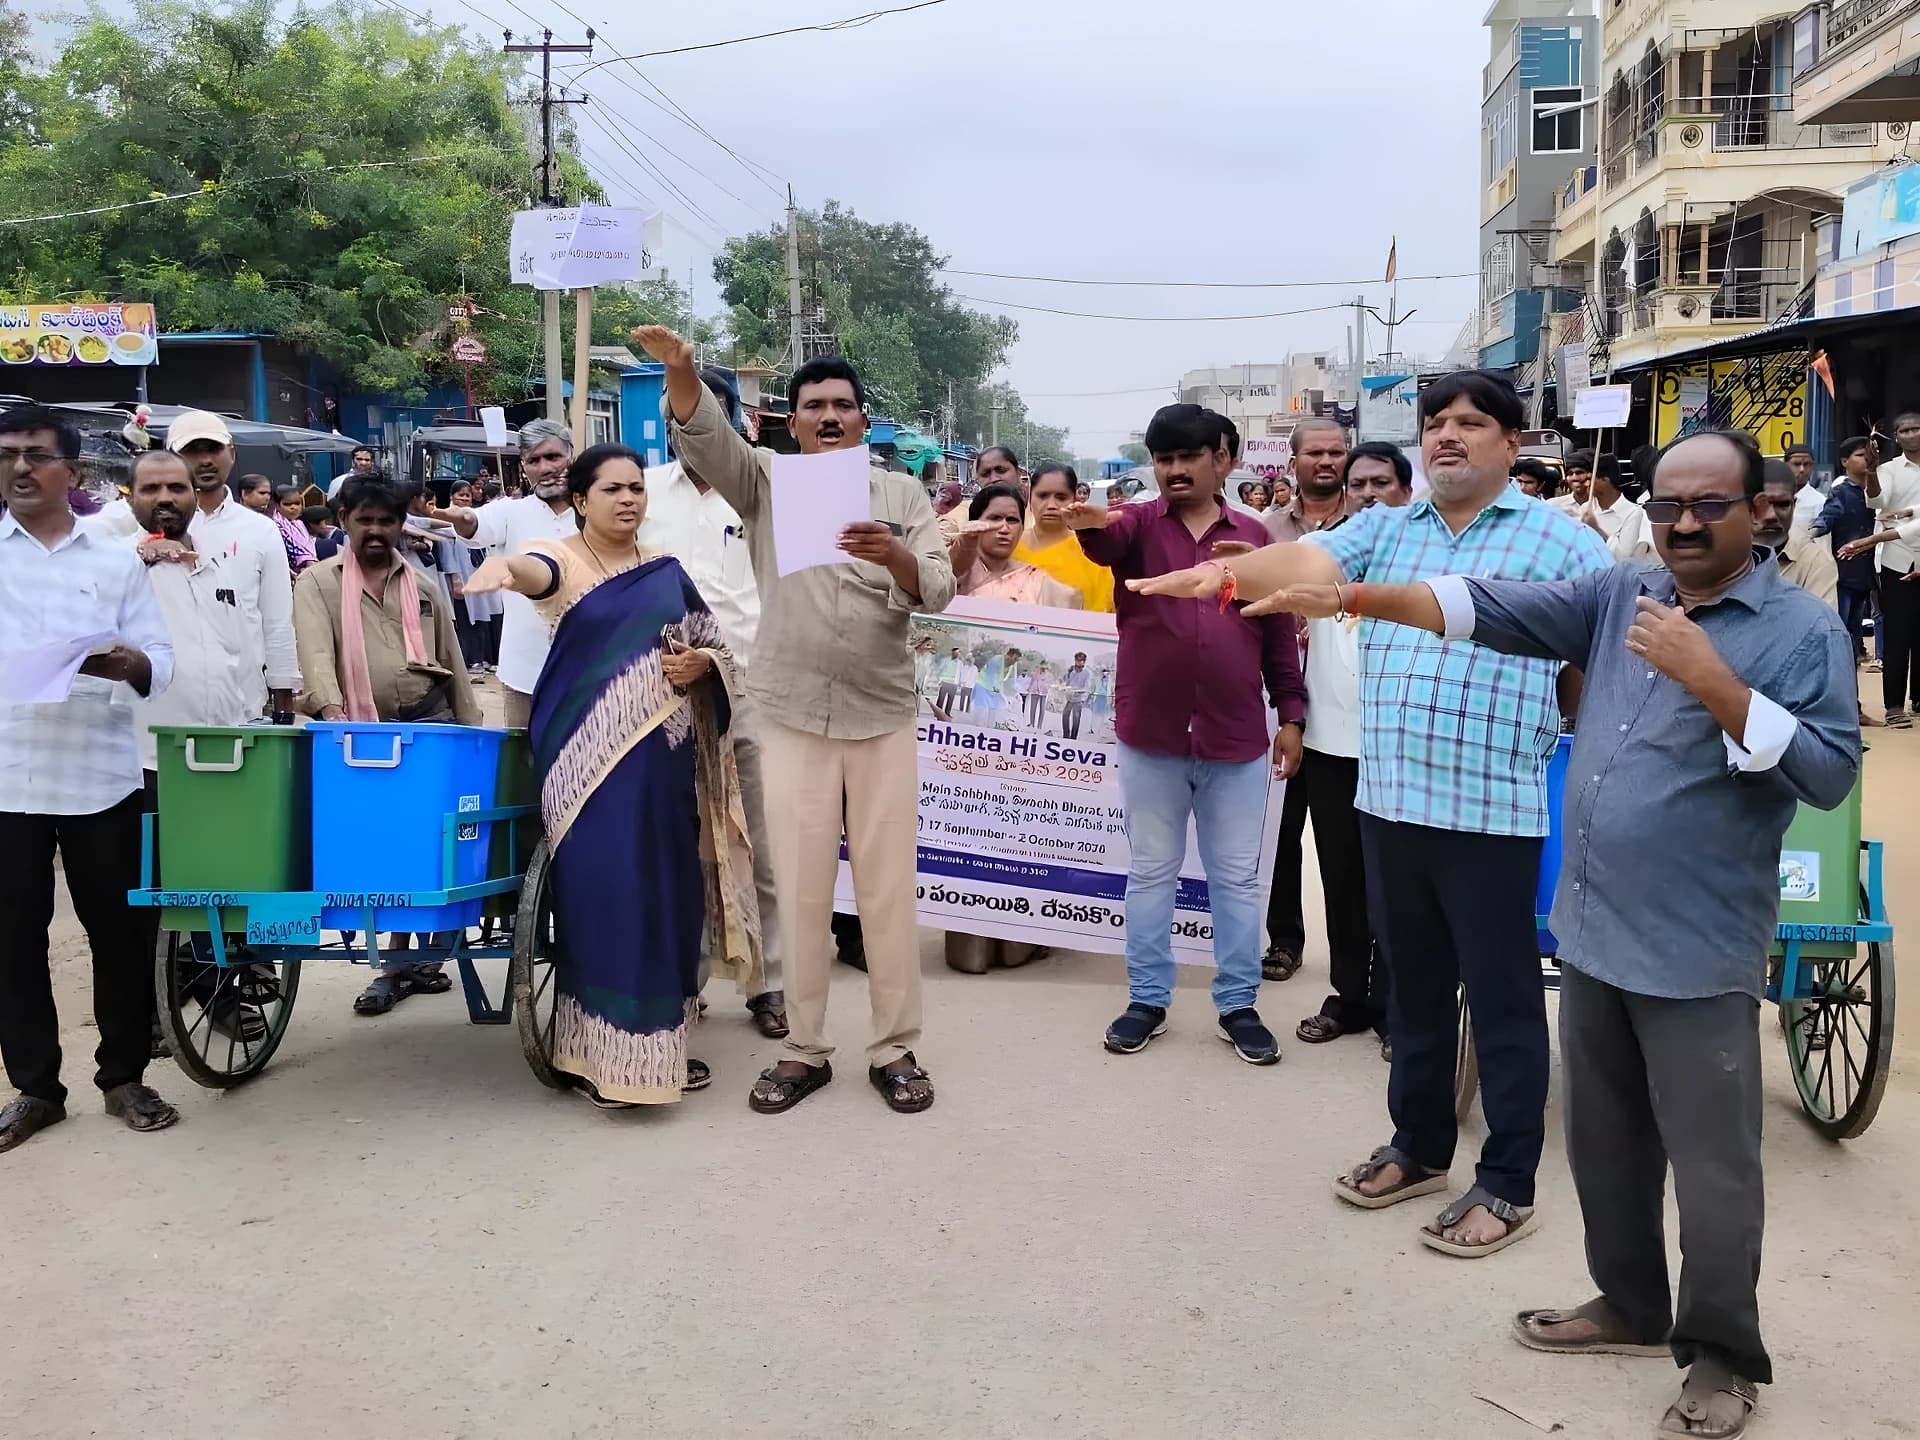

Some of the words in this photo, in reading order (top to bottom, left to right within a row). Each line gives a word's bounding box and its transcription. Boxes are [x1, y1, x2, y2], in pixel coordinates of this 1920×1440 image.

[917, 723, 1000, 753] chhata
[1010, 736, 1038, 758] Hi
[1044, 742, 1107, 767] Seva
[1041, 898, 1125, 927] దేవనకొం
